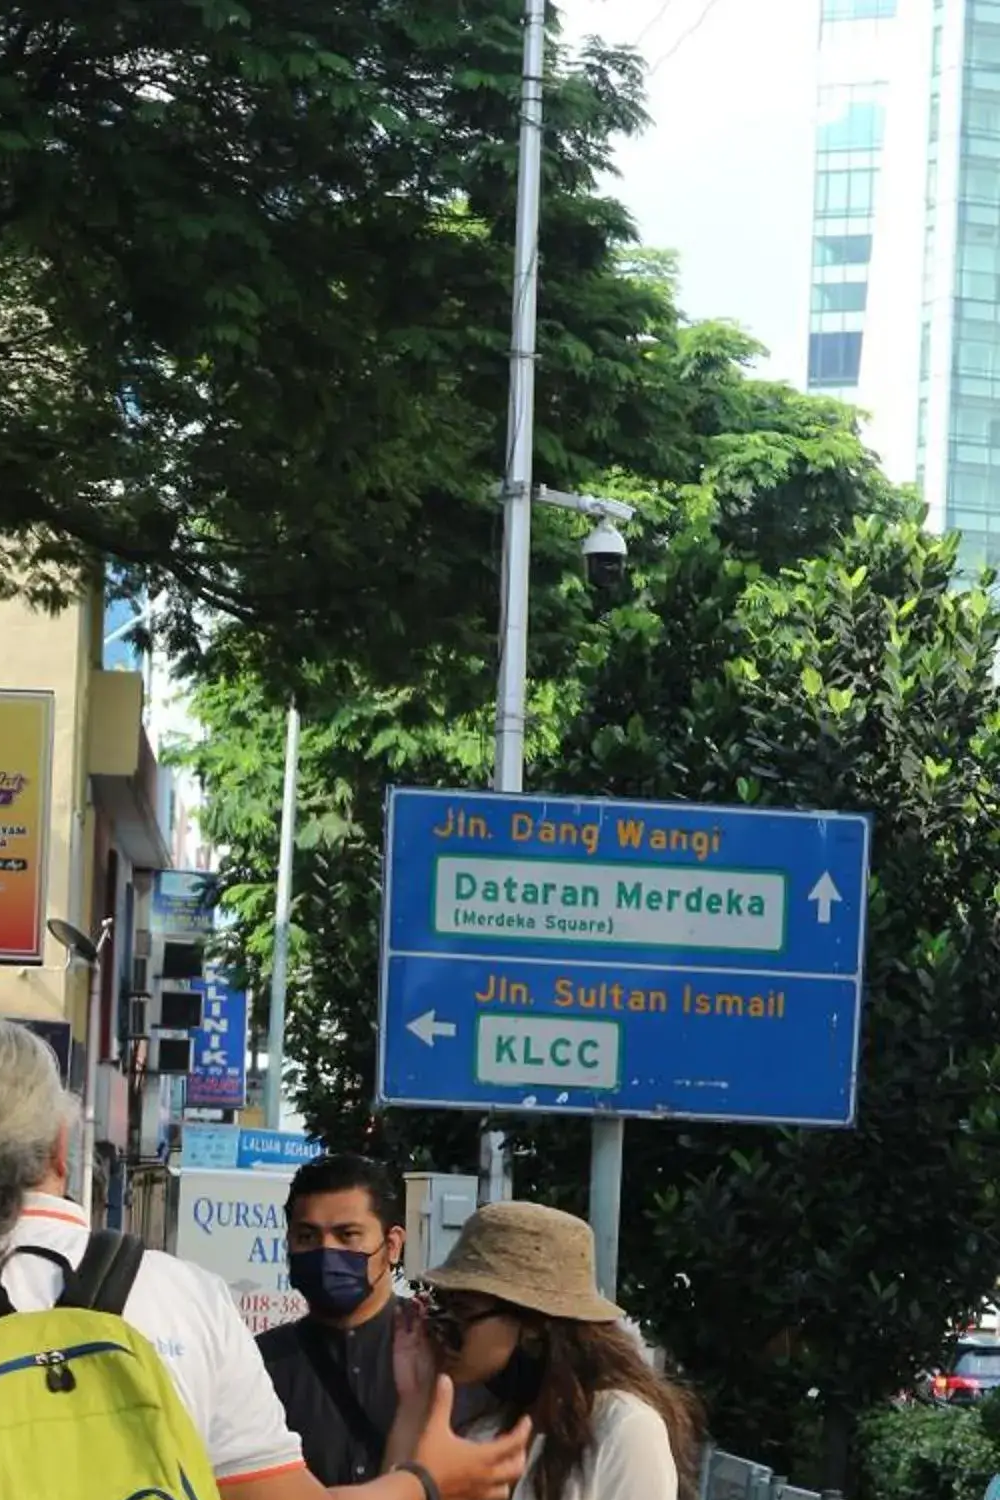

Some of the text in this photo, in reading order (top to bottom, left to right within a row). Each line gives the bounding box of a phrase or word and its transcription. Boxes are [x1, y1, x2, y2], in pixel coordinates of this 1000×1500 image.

[434, 809, 720, 858] Jln. Dang Wangi
[455, 872, 766, 917] Dataran Merdeka
[454, 909, 614, 935] (Merdeka Square)
[202, 963, 230, 1065] KLINIK
[475, 976, 785, 1018] Jln. Sultan Ismail
[495, 1035, 600, 1069] KLCC
[193, 1198, 286, 1235] QURSA
